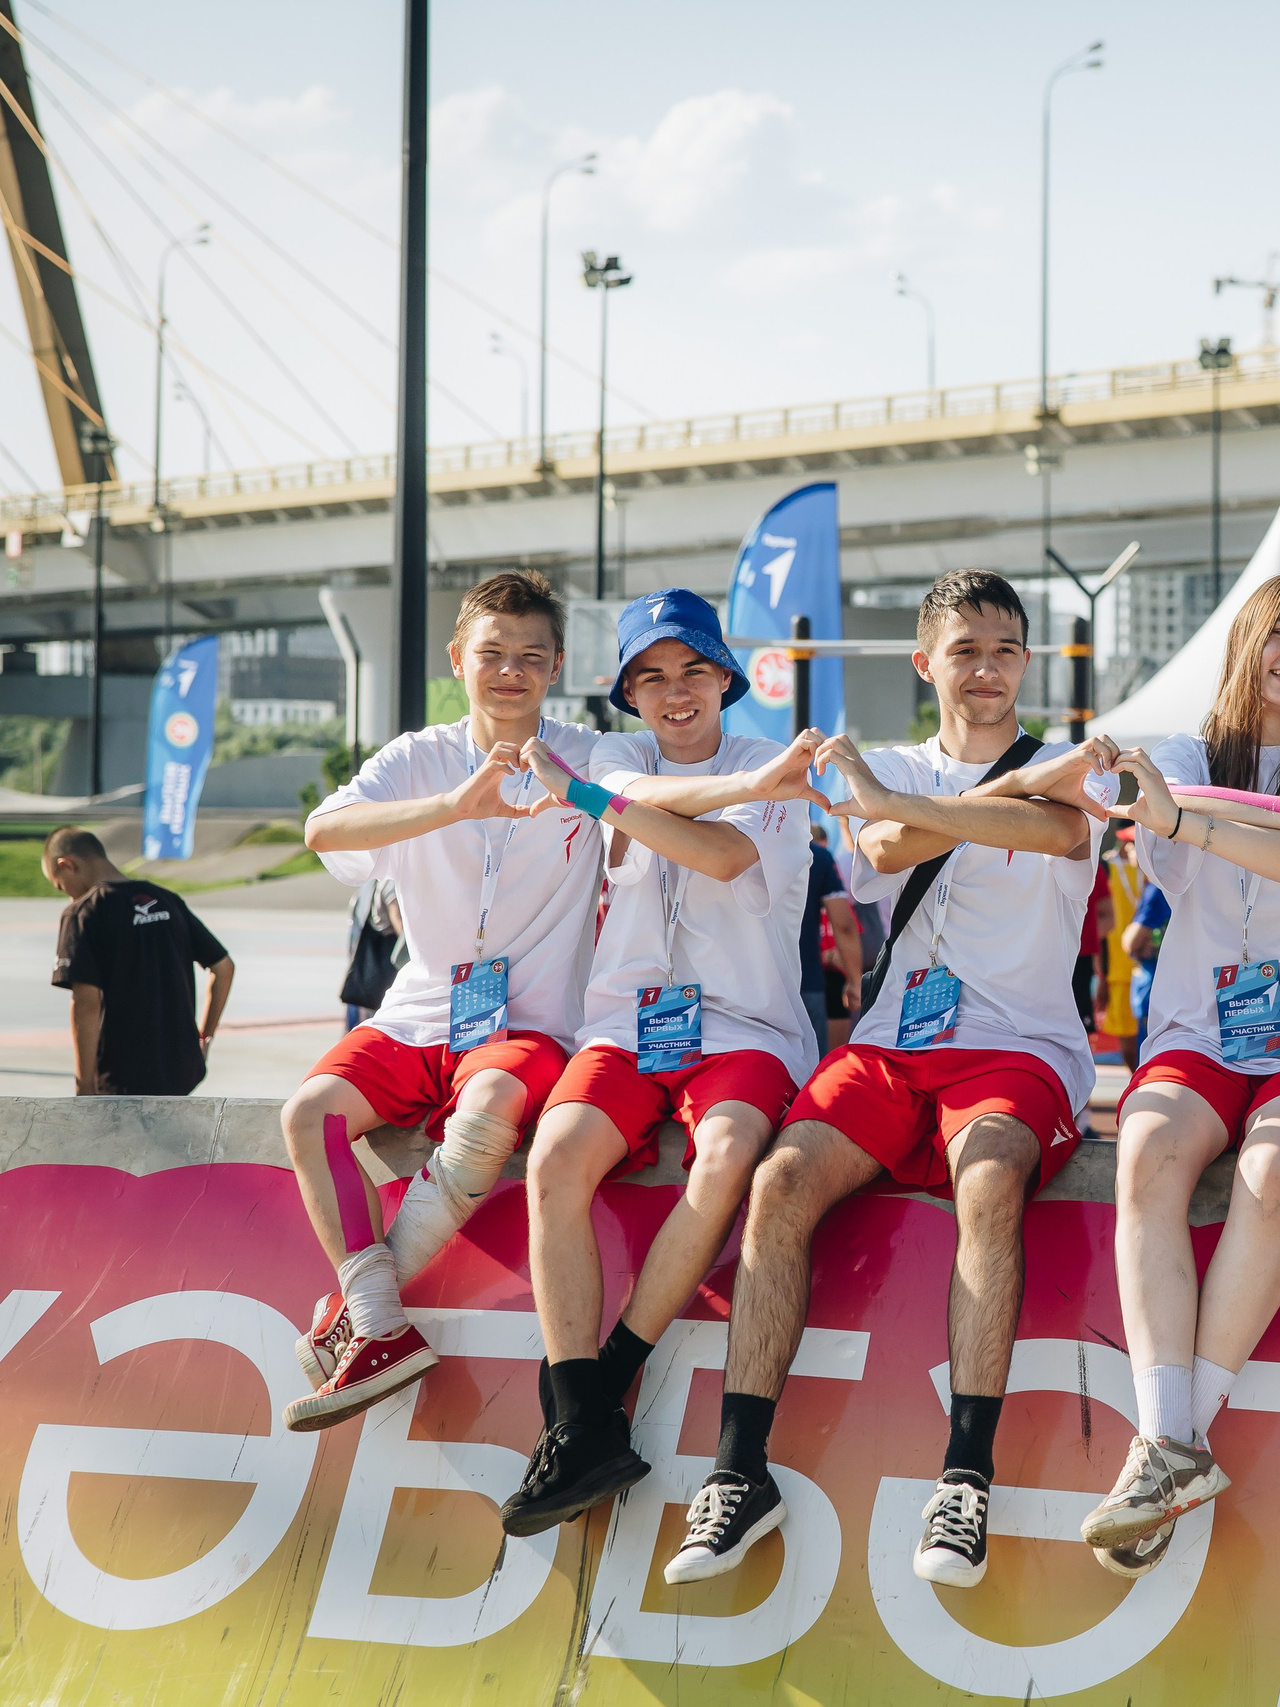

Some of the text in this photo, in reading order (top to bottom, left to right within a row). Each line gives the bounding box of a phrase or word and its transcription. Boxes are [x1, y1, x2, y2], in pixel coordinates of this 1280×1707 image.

[560, 813, 583, 824] Первые
[1229, 997, 1264, 1008] ВЫЗОВ
[1224, 1006, 1265, 1017] ПЕРВЫХ
[460, 1019, 491, 1030] ВЫЗОВ
[649, 1016, 684, 1025] ВЫЗОВ
[908, 1020, 940, 1031] ВЫЗОВ
[454, 1027, 491, 1040] ПЕРВЫХ
[644, 1024, 683, 1034] ПЕРВЫХ
[902, 1027, 939, 1039] ПЕРВЫХ
[1230, 1024, 1276, 1036] УЧАСТНИК
[648, 1041, 692, 1050] УЧАСТНИК
